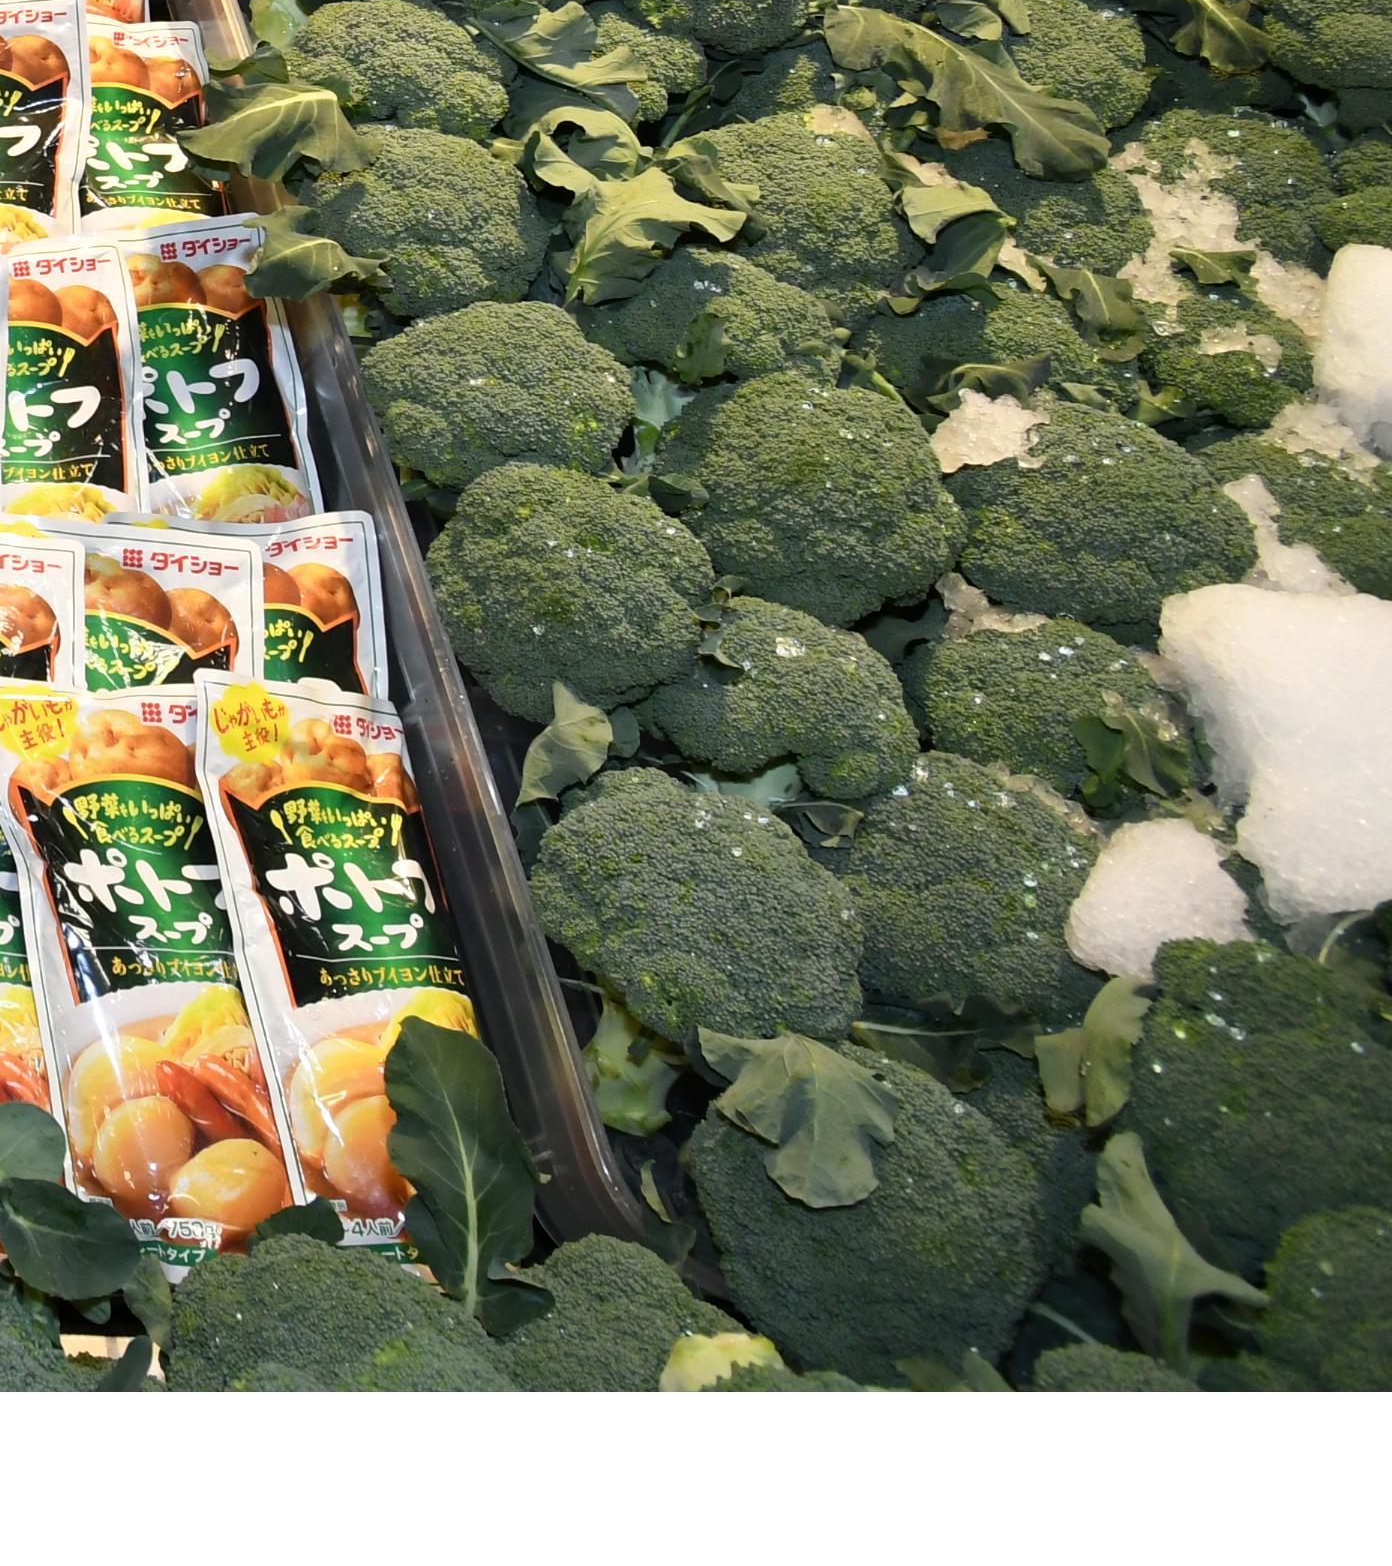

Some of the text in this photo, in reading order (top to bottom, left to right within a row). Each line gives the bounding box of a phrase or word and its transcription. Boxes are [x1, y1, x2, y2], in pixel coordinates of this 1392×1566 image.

[95, 170, 164, 190] スープ
[182, 237, 251, 258] ダイショー
[35, 257, 111, 277] ダイショー
[155, 408, 231, 445] スープ
[266, 535, 354, 558] ダイショー
[149, 549, 240, 576] ダイショー
[22, 717, 66, 751] 主役!
[242, 724, 279, 752] 主役!
[357, 717, 405, 741] ダイショー
[265, 853, 436, 920] ポトフ
[128, 912, 214, 945] スープ
[332, 913, 424, 950] スープ
[320, 966, 466, 987] あっさりブイヨン仕立て
